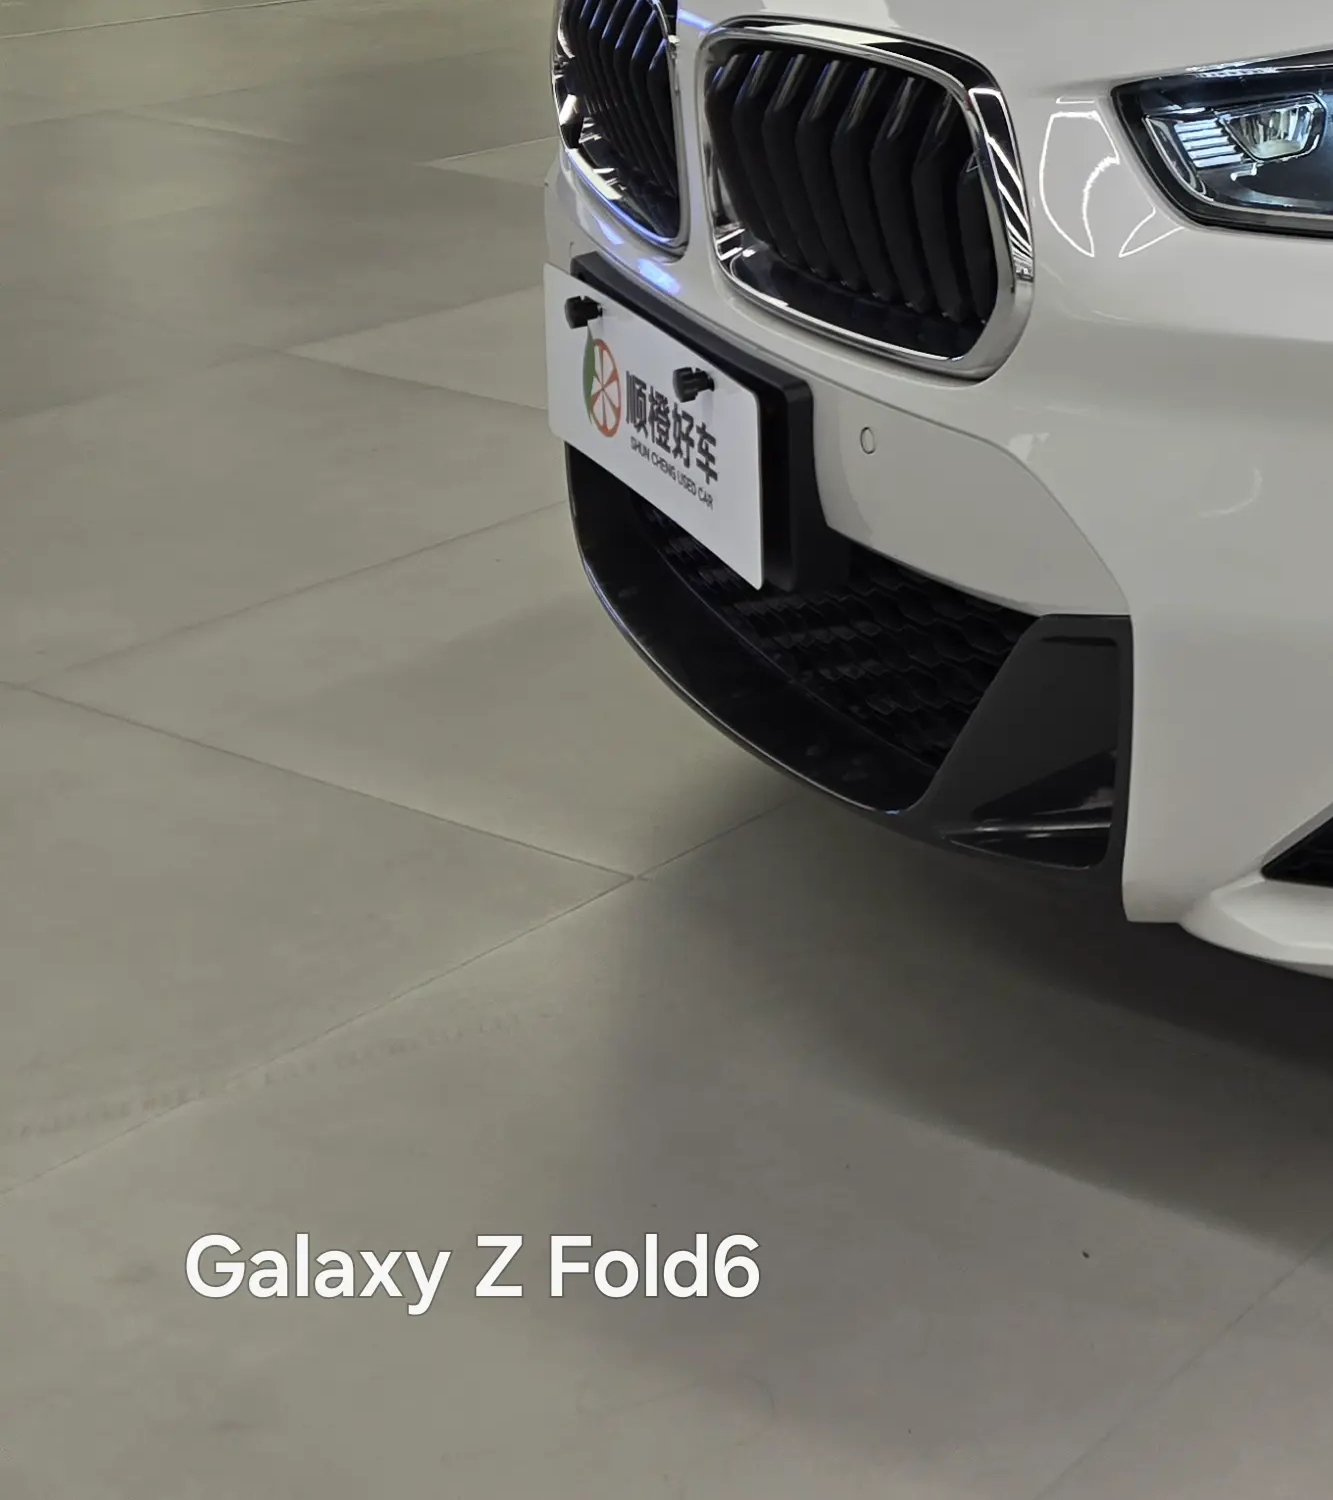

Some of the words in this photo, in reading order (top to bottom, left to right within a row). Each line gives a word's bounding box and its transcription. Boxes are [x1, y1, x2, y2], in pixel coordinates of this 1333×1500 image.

[625, 370, 718, 486] 顺橙好车
[630, 435, 650, 462] SHUN
[651, 451, 677, 482] CHENG
[677, 469, 697, 497] USED
[698, 487, 714, 511] CAR
